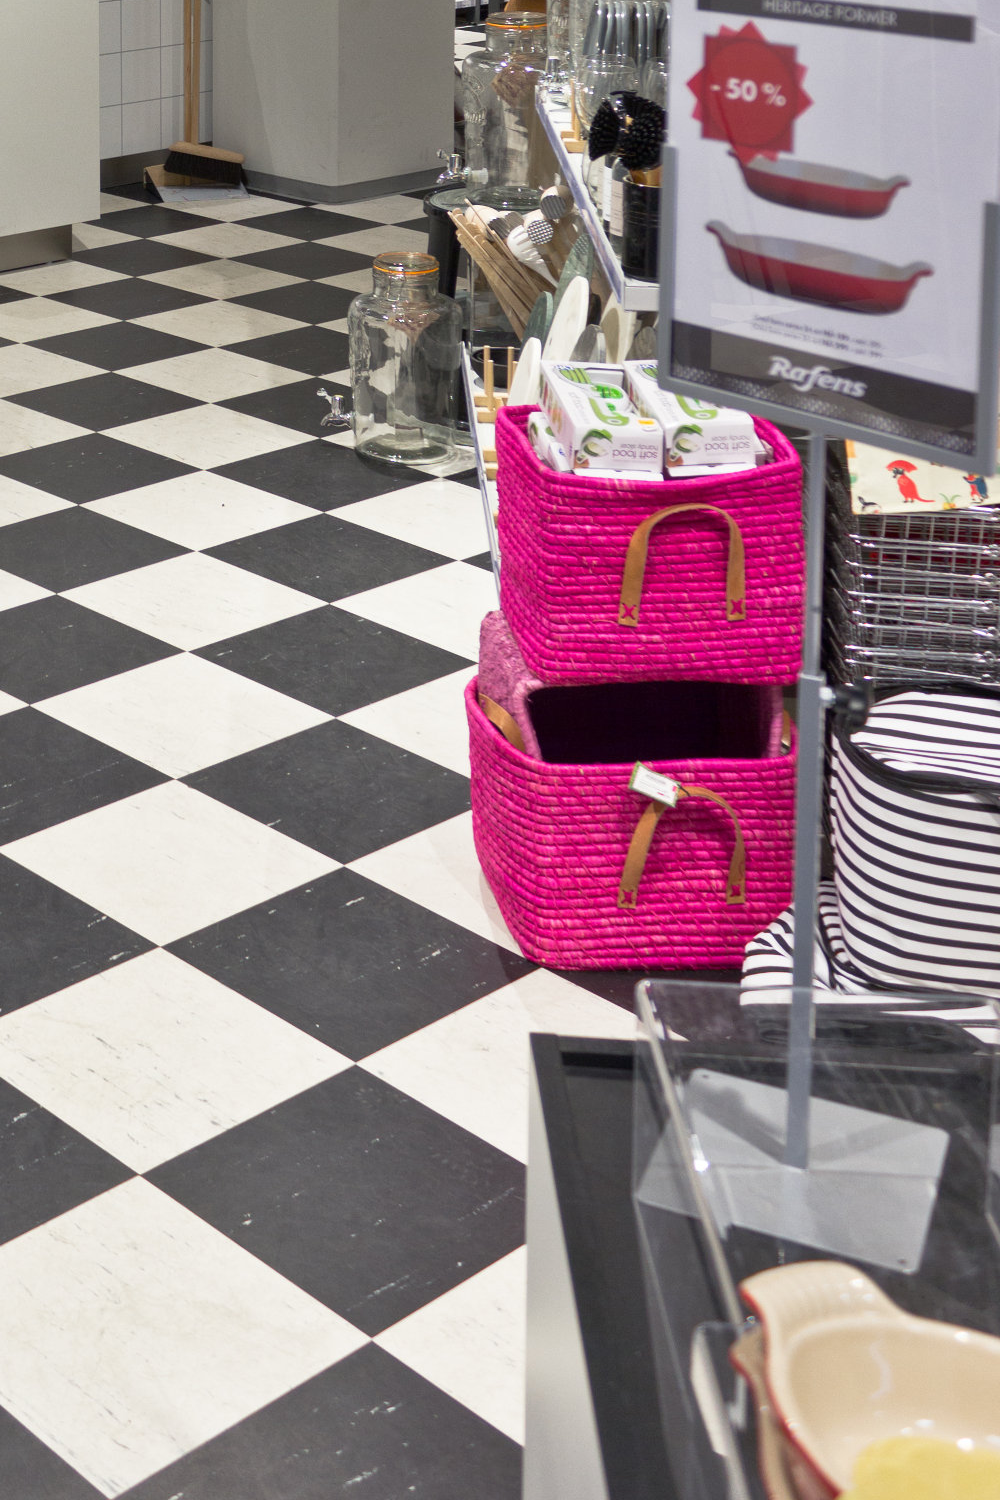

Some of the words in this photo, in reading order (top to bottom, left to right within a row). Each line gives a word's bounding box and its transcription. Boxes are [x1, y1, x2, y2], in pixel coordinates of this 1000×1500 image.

[834, 3, 898, 27] FORMER
[725, 78, 757, 102] 50
[762, 82, 787, 107] %
[767, 355, 868, 398] Rafens
[705, 442, 730, 451] food
[732, 440, 751, 450] soft
[612, 449, 637, 459] food
[639, 450, 658, 459] soft
